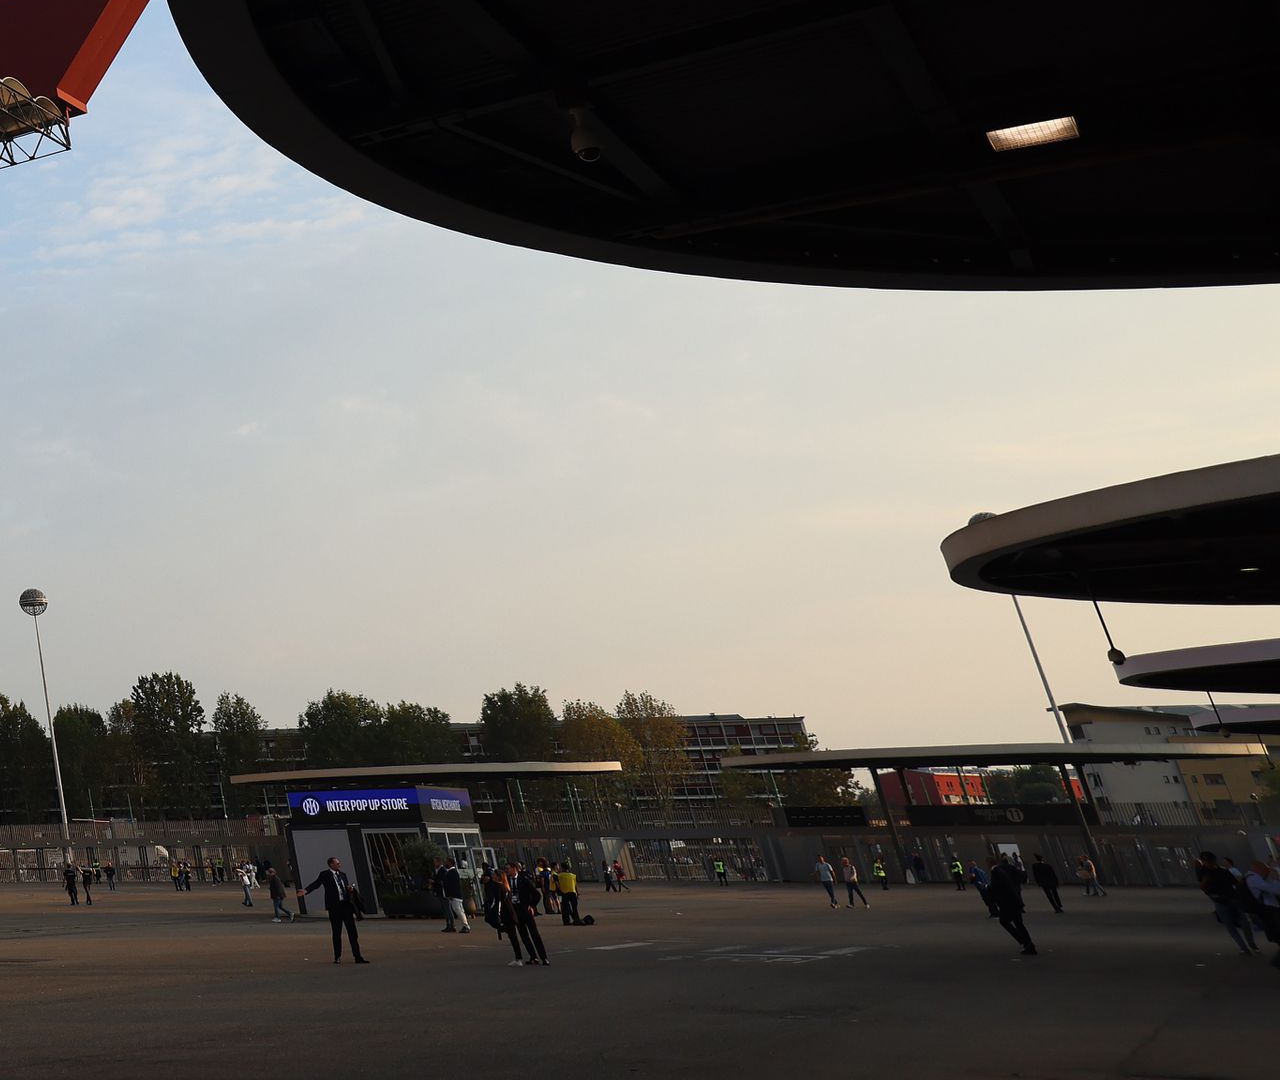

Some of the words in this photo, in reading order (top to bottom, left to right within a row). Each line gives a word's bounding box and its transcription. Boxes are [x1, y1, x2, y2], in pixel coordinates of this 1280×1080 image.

[325, 800, 351, 812] INTER
[351, 799, 367, 811] POP
[369, 799, 380, 811] UP
[380, 797, 409, 810] STORE
